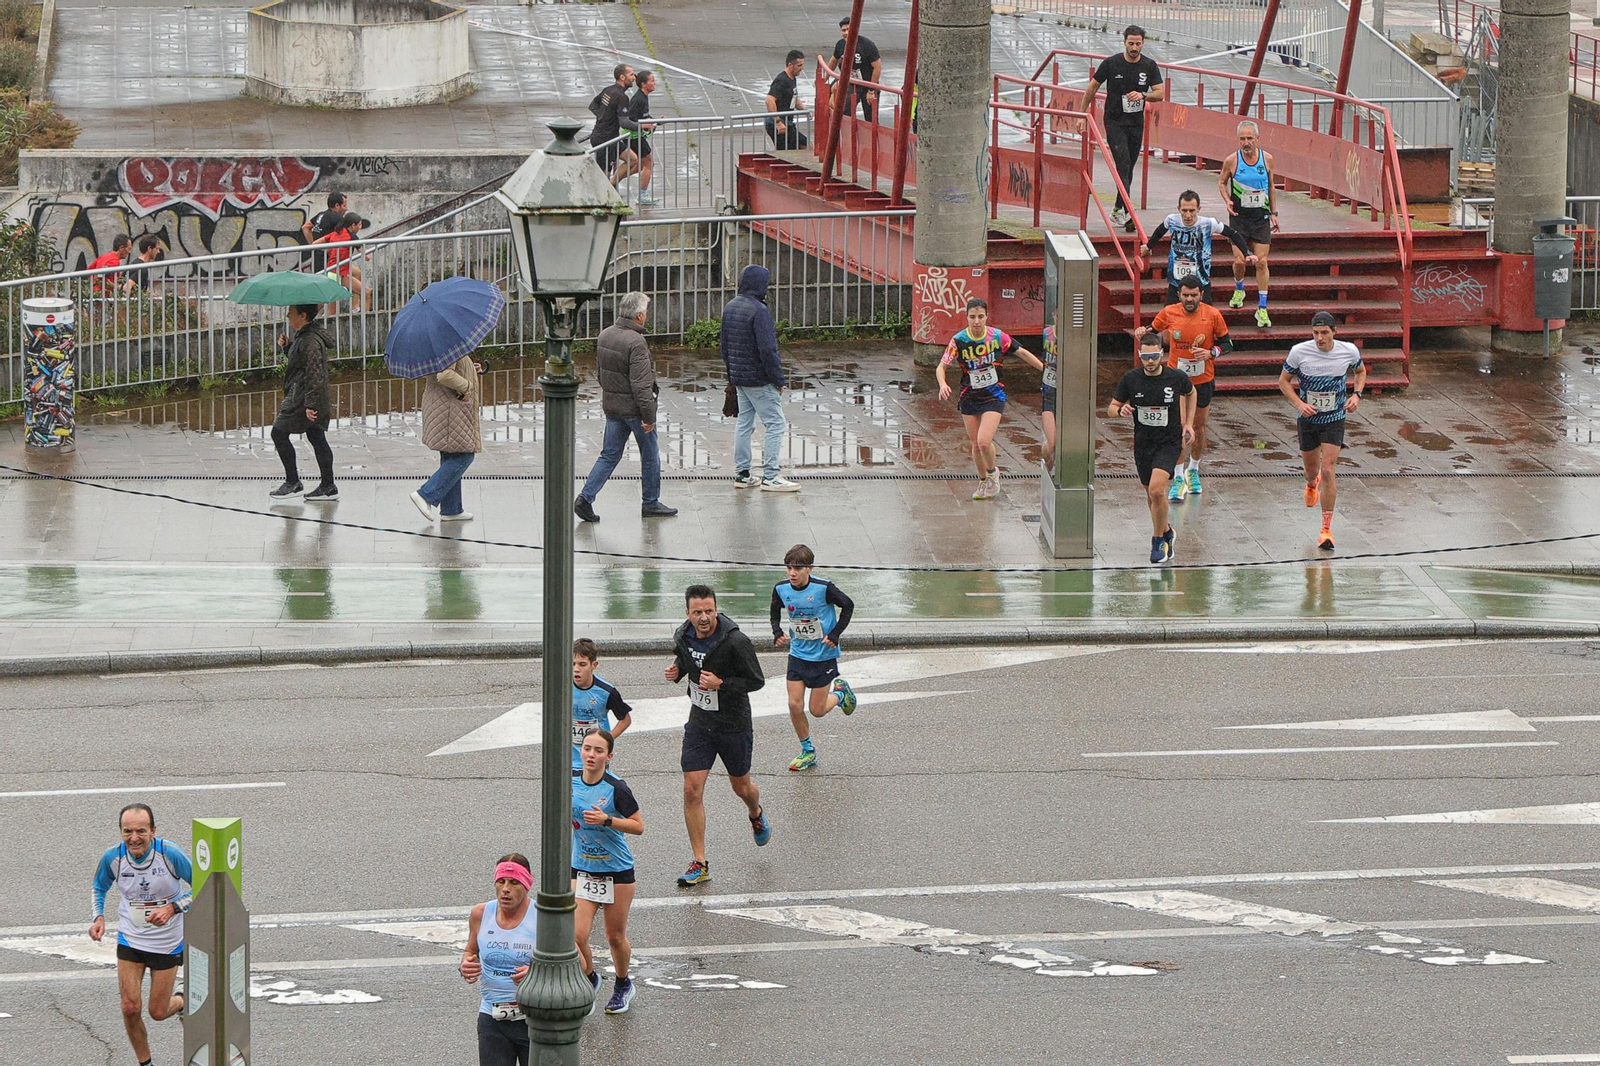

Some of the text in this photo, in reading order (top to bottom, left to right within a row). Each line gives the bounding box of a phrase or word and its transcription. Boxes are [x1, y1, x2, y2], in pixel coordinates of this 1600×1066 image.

[1139, 72, 1148, 82] S
[1126, 99, 1141, 108] 328
[1249, 195, 1260, 203] 14
[1176, 267, 1192, 276] 109
[1185, 364, 1197, 372] 21
[974, 372, 993, 384] 343
[1163, 386, 1174, 399] S
[1311, 398, 1331, 407] 212
[1143, 412, 1162, 421] 382
[795, 624, 816, 635] 445
[583, 881, 607, 895] 433
[486, 941, 510, 950] COSTA
